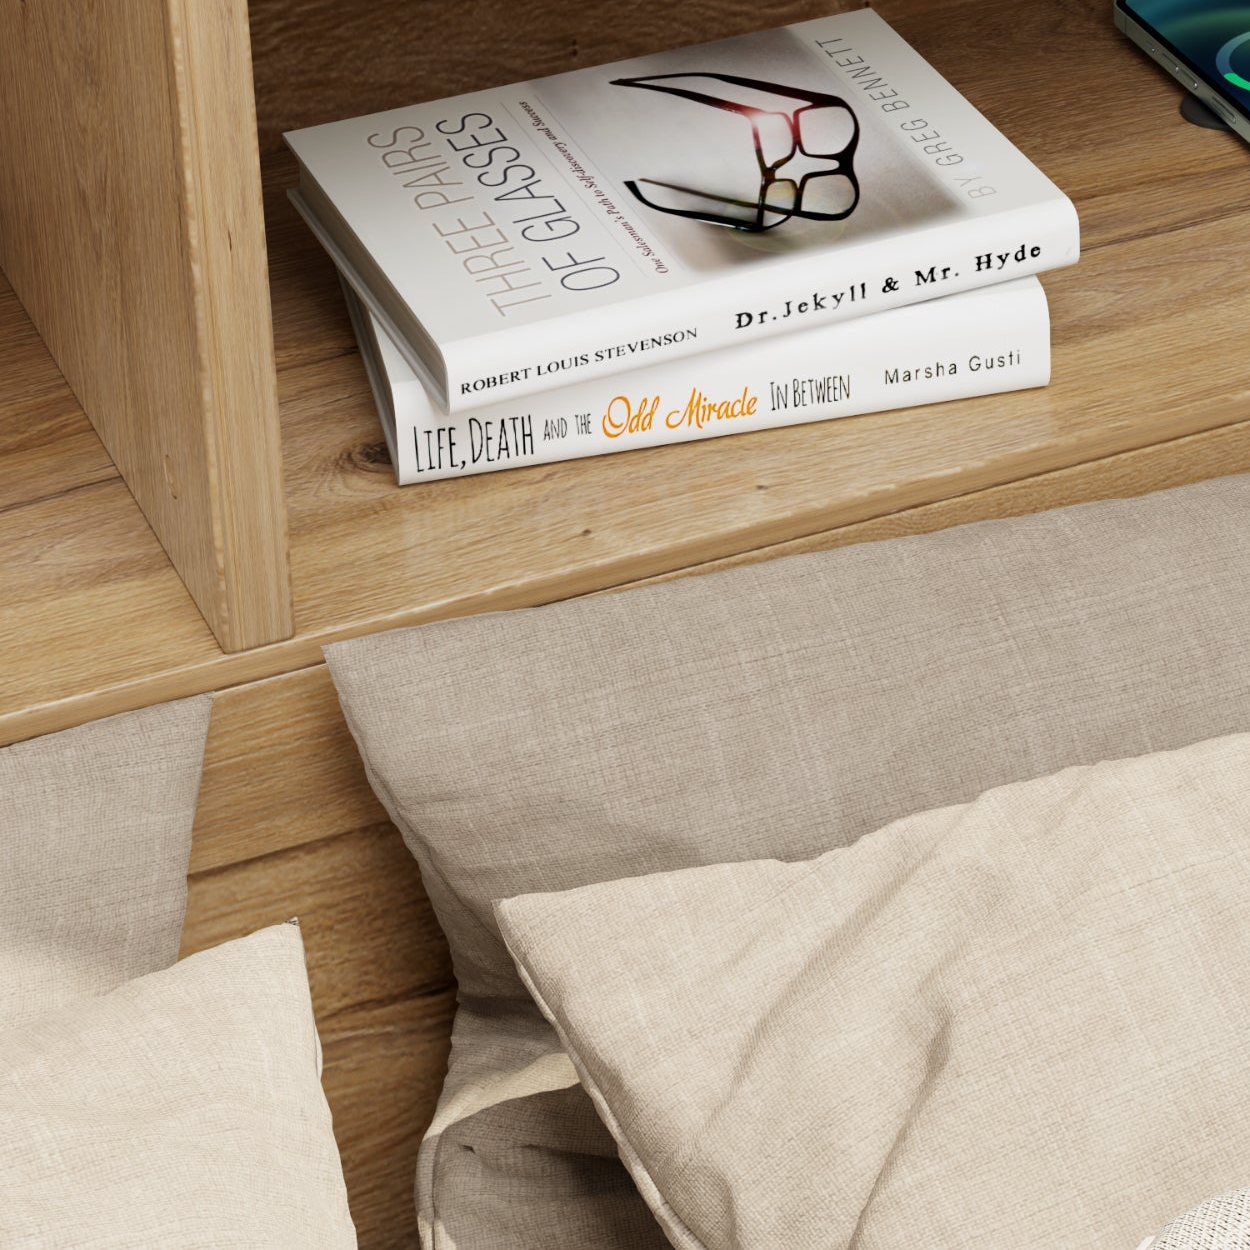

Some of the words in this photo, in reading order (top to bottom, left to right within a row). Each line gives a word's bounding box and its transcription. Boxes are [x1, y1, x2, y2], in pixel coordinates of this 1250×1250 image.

[815, 38, 910, 113] BENNETT
[519, 101, 545, 127] Success
[537, 127, 557, 140] and
[900, 118, 964, 166] GREG
[367, 126, 475, 210] PAIRS
[435, 112, 580, 242] GLASSES
[552, 141, 598, 189] Self-discovery
[952, 176, 997, 198] BY
[594, 189, 604, 199] to
[599, 200, 618, 216] Path
[614, 215, 654, 257] Salesman's
[432, 211, 552, 317] THREE
[541, 252, 620, 291] OF
[650, 257, 669, 274] One
[881, 276, 900, 294] &
[914, 265, 960, 286] Mr.
[975, 244, 1042, 272] Hyde
[459, 367, 532, 395] ROBERT
[536, 353, 590, 377] LOUIS
[594, 327, 698, 362] STEVENSON
[884, 362, 958, 385] Marsha
[968, 349, 1022, 373] Gusti
[543, 417, 568, 442] AND
[574, 412, 593, 436] THE
[601, 395, 661, 439] Odd
[665, 385, 758, 430] Miracle
